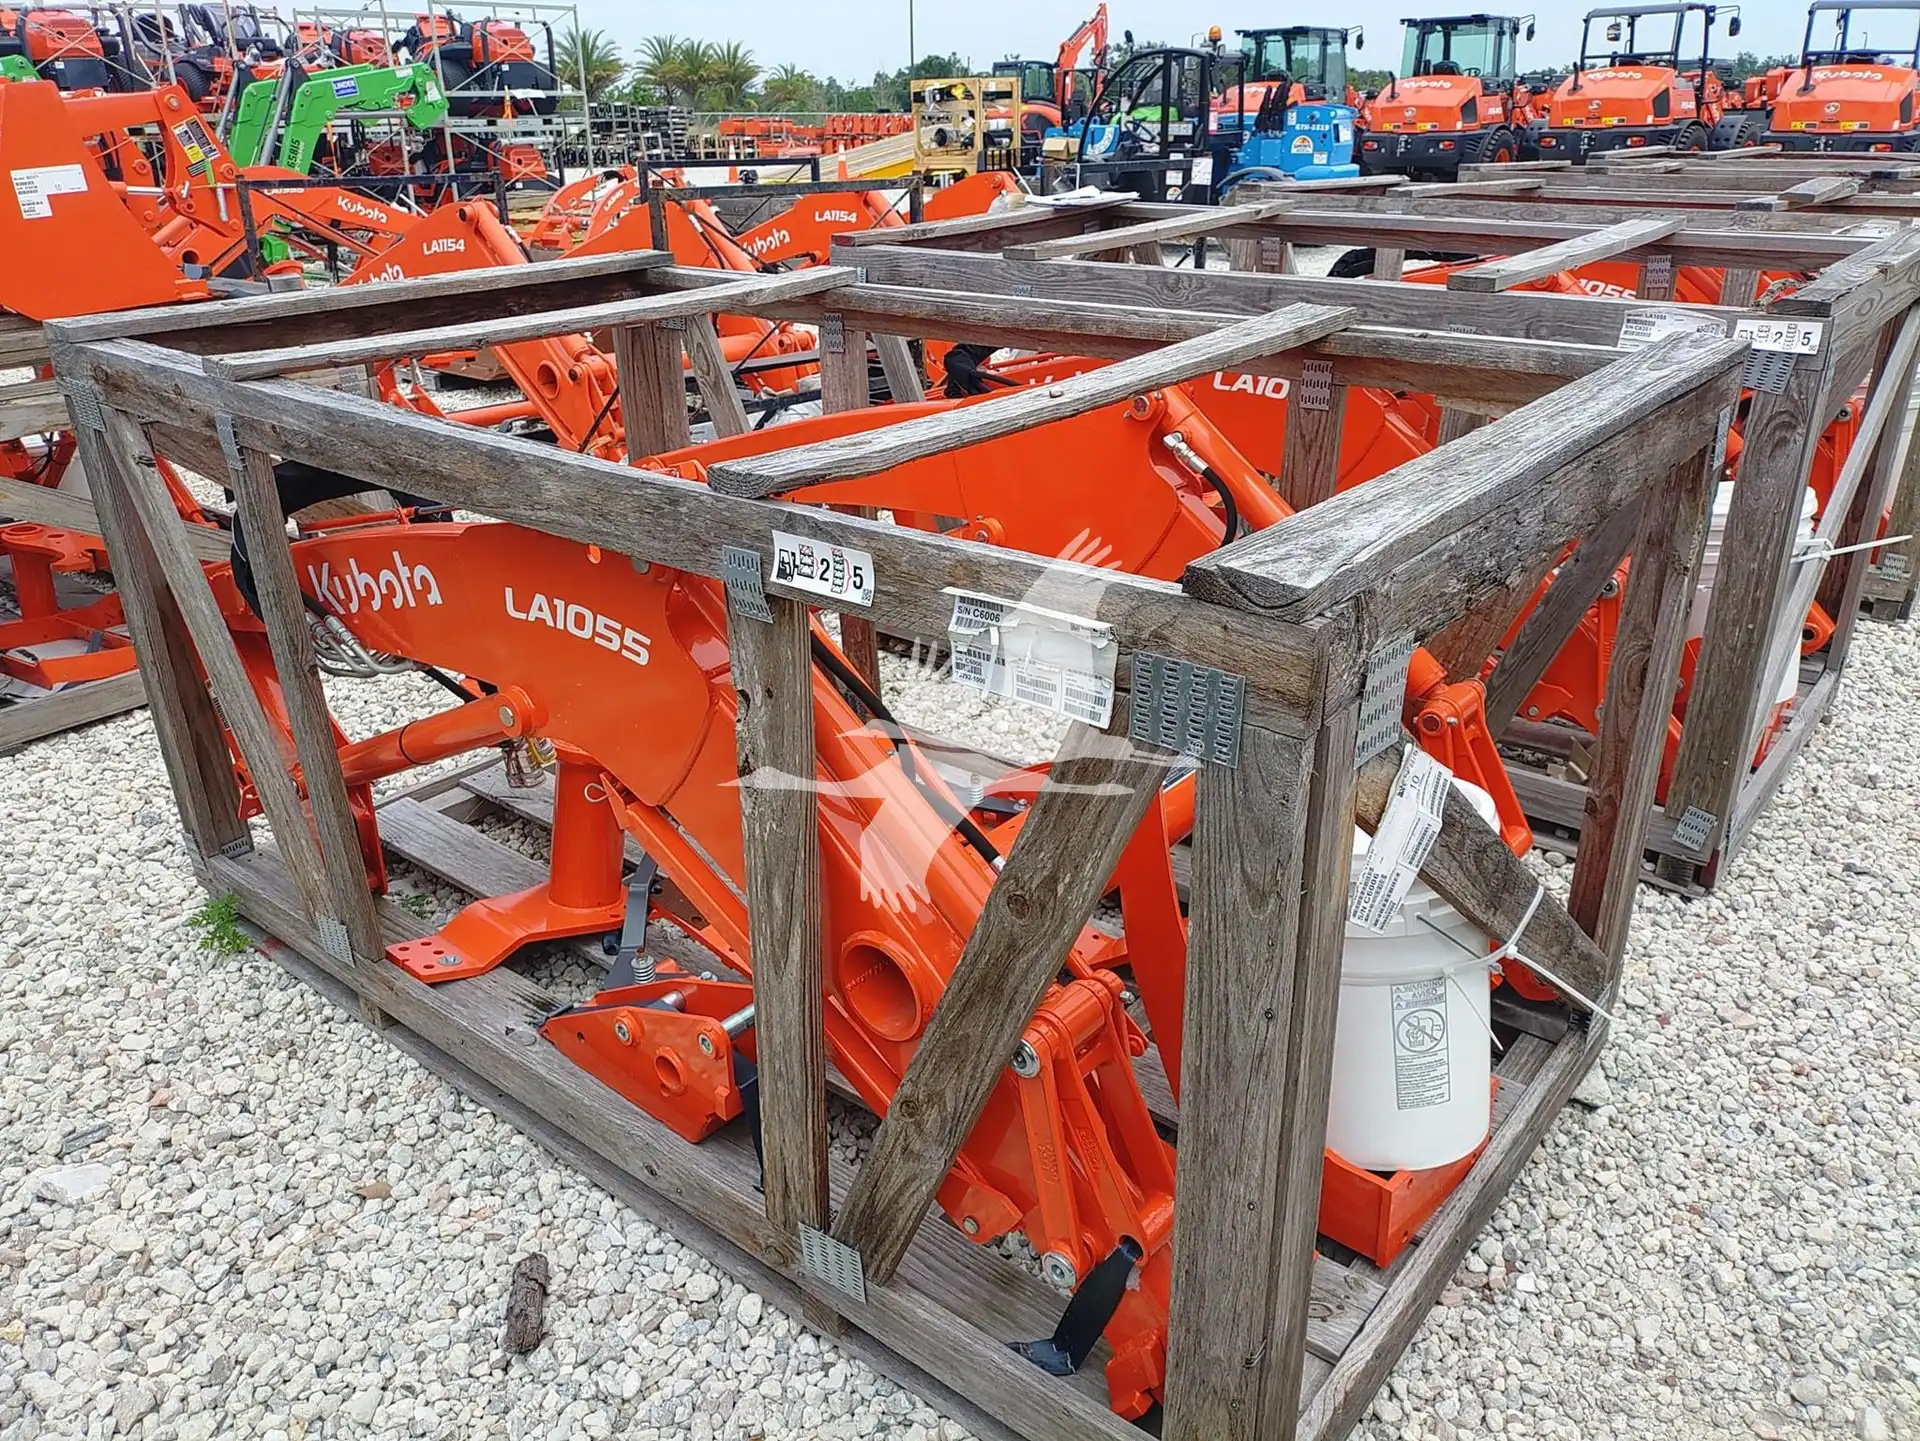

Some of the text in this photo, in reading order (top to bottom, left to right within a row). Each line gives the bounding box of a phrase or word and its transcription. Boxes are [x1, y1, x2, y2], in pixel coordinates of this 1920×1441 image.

[337, 195, 388, 224] Kubota
[815, 211, 858, 223] LA1154
[422, 238, 466, 256] LA1154
[743, 228, 791, 257] ubota
[1773, 331, 1813, 346] 2 5
[1213, 371, 1290, 399] LA10
[308, 550, 443, 615] Kubota
[819, 558, 864, 590] 2 5
[504, 586, 652, 666] LA1055
[957, 605, 1001, 623] S/N C6006
[1364, 873, 1380, 905] C6006
